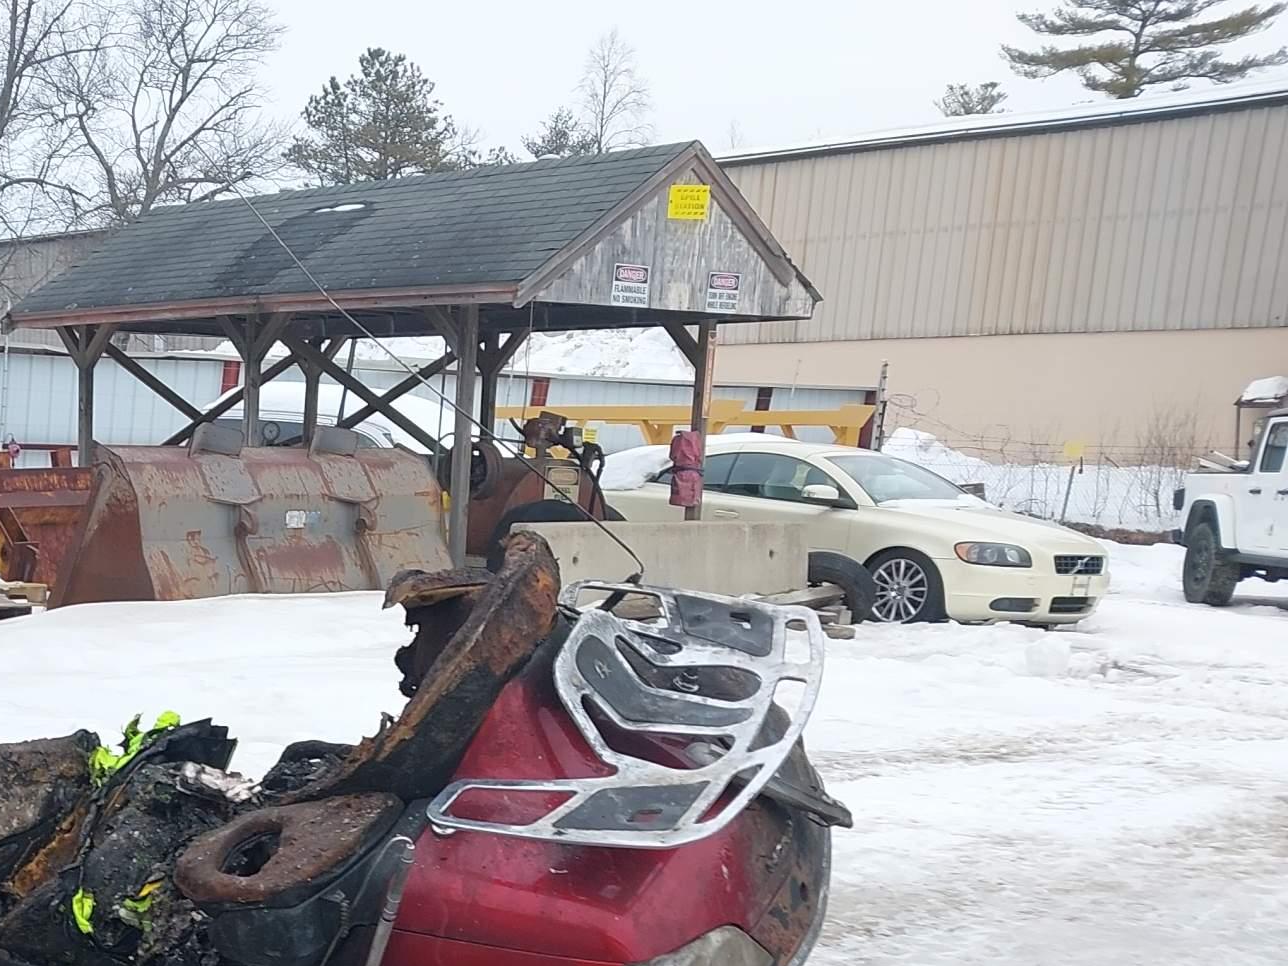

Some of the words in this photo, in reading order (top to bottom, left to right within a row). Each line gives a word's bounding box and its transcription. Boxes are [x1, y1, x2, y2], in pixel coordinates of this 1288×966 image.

[619, 268, 645, 280] DANGER
[713, 277, 736, 287] DANGER
[614, 284, 647, 294] FLAMMABLE
[612, 294, 621, 302] NO
[622, 295, 646, 304] SMOKING
